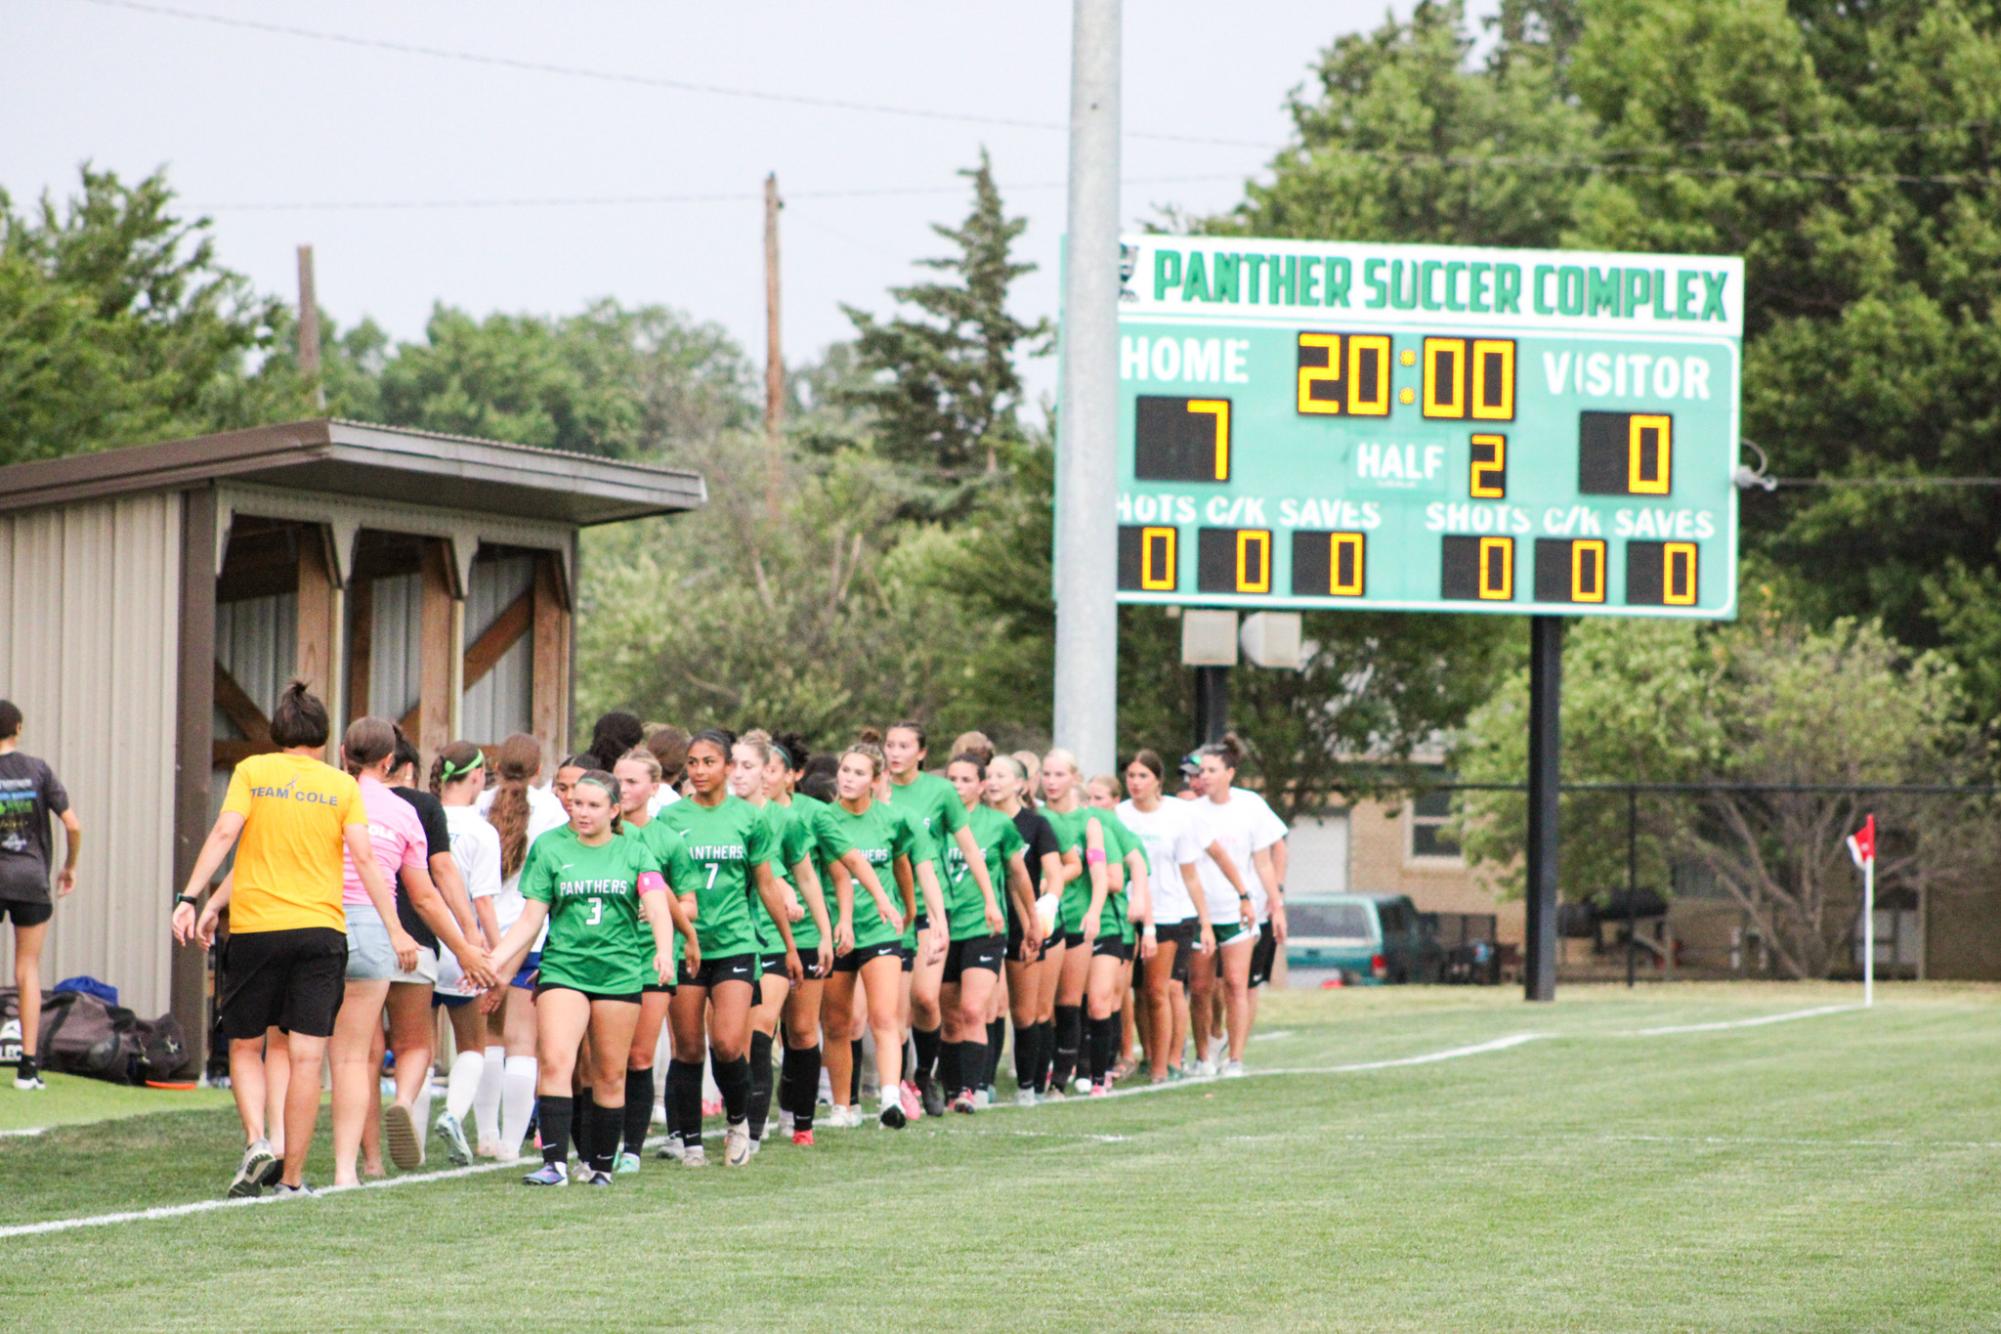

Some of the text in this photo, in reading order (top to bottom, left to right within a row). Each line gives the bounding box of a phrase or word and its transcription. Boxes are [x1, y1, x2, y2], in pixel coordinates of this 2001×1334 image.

[1154, 249, 1352, 308] PANTHER
[1533, 263, 1728, 322] COMPLEX
[1119, 335, 1249, 383] HOME
[1298, 332, 1515, 420] 20:00
[1543, 351, 1711, 400] VISITOR
[1187, 399, 1229, 480] 7
[1357, 442, 1444, 480] HALF
[1470, 434, 1505, 498] 2
[1628, 414, 1671, 494] 0
[1115, 493, 1381, 529] HOTS C/K SAVES
[1425, 501, 1715, 539] SHOTS C/K SAVES
[1141, 526, 1176, 590] 0
[1236, 529, 1271, 593] 0
[1329, 532, 1363, 596] 0
[1479, 536, 1513, 600] 0
[1571, 539, 1605, 603] 0
[1663, 542, 1697, 605] 0
[250, 786, 338, 807] TEAM COLE
[559, 879, 628, 896] PANTHERS
[704, 862, 719, 890] 7
[586, 897, 602, 925] 3
